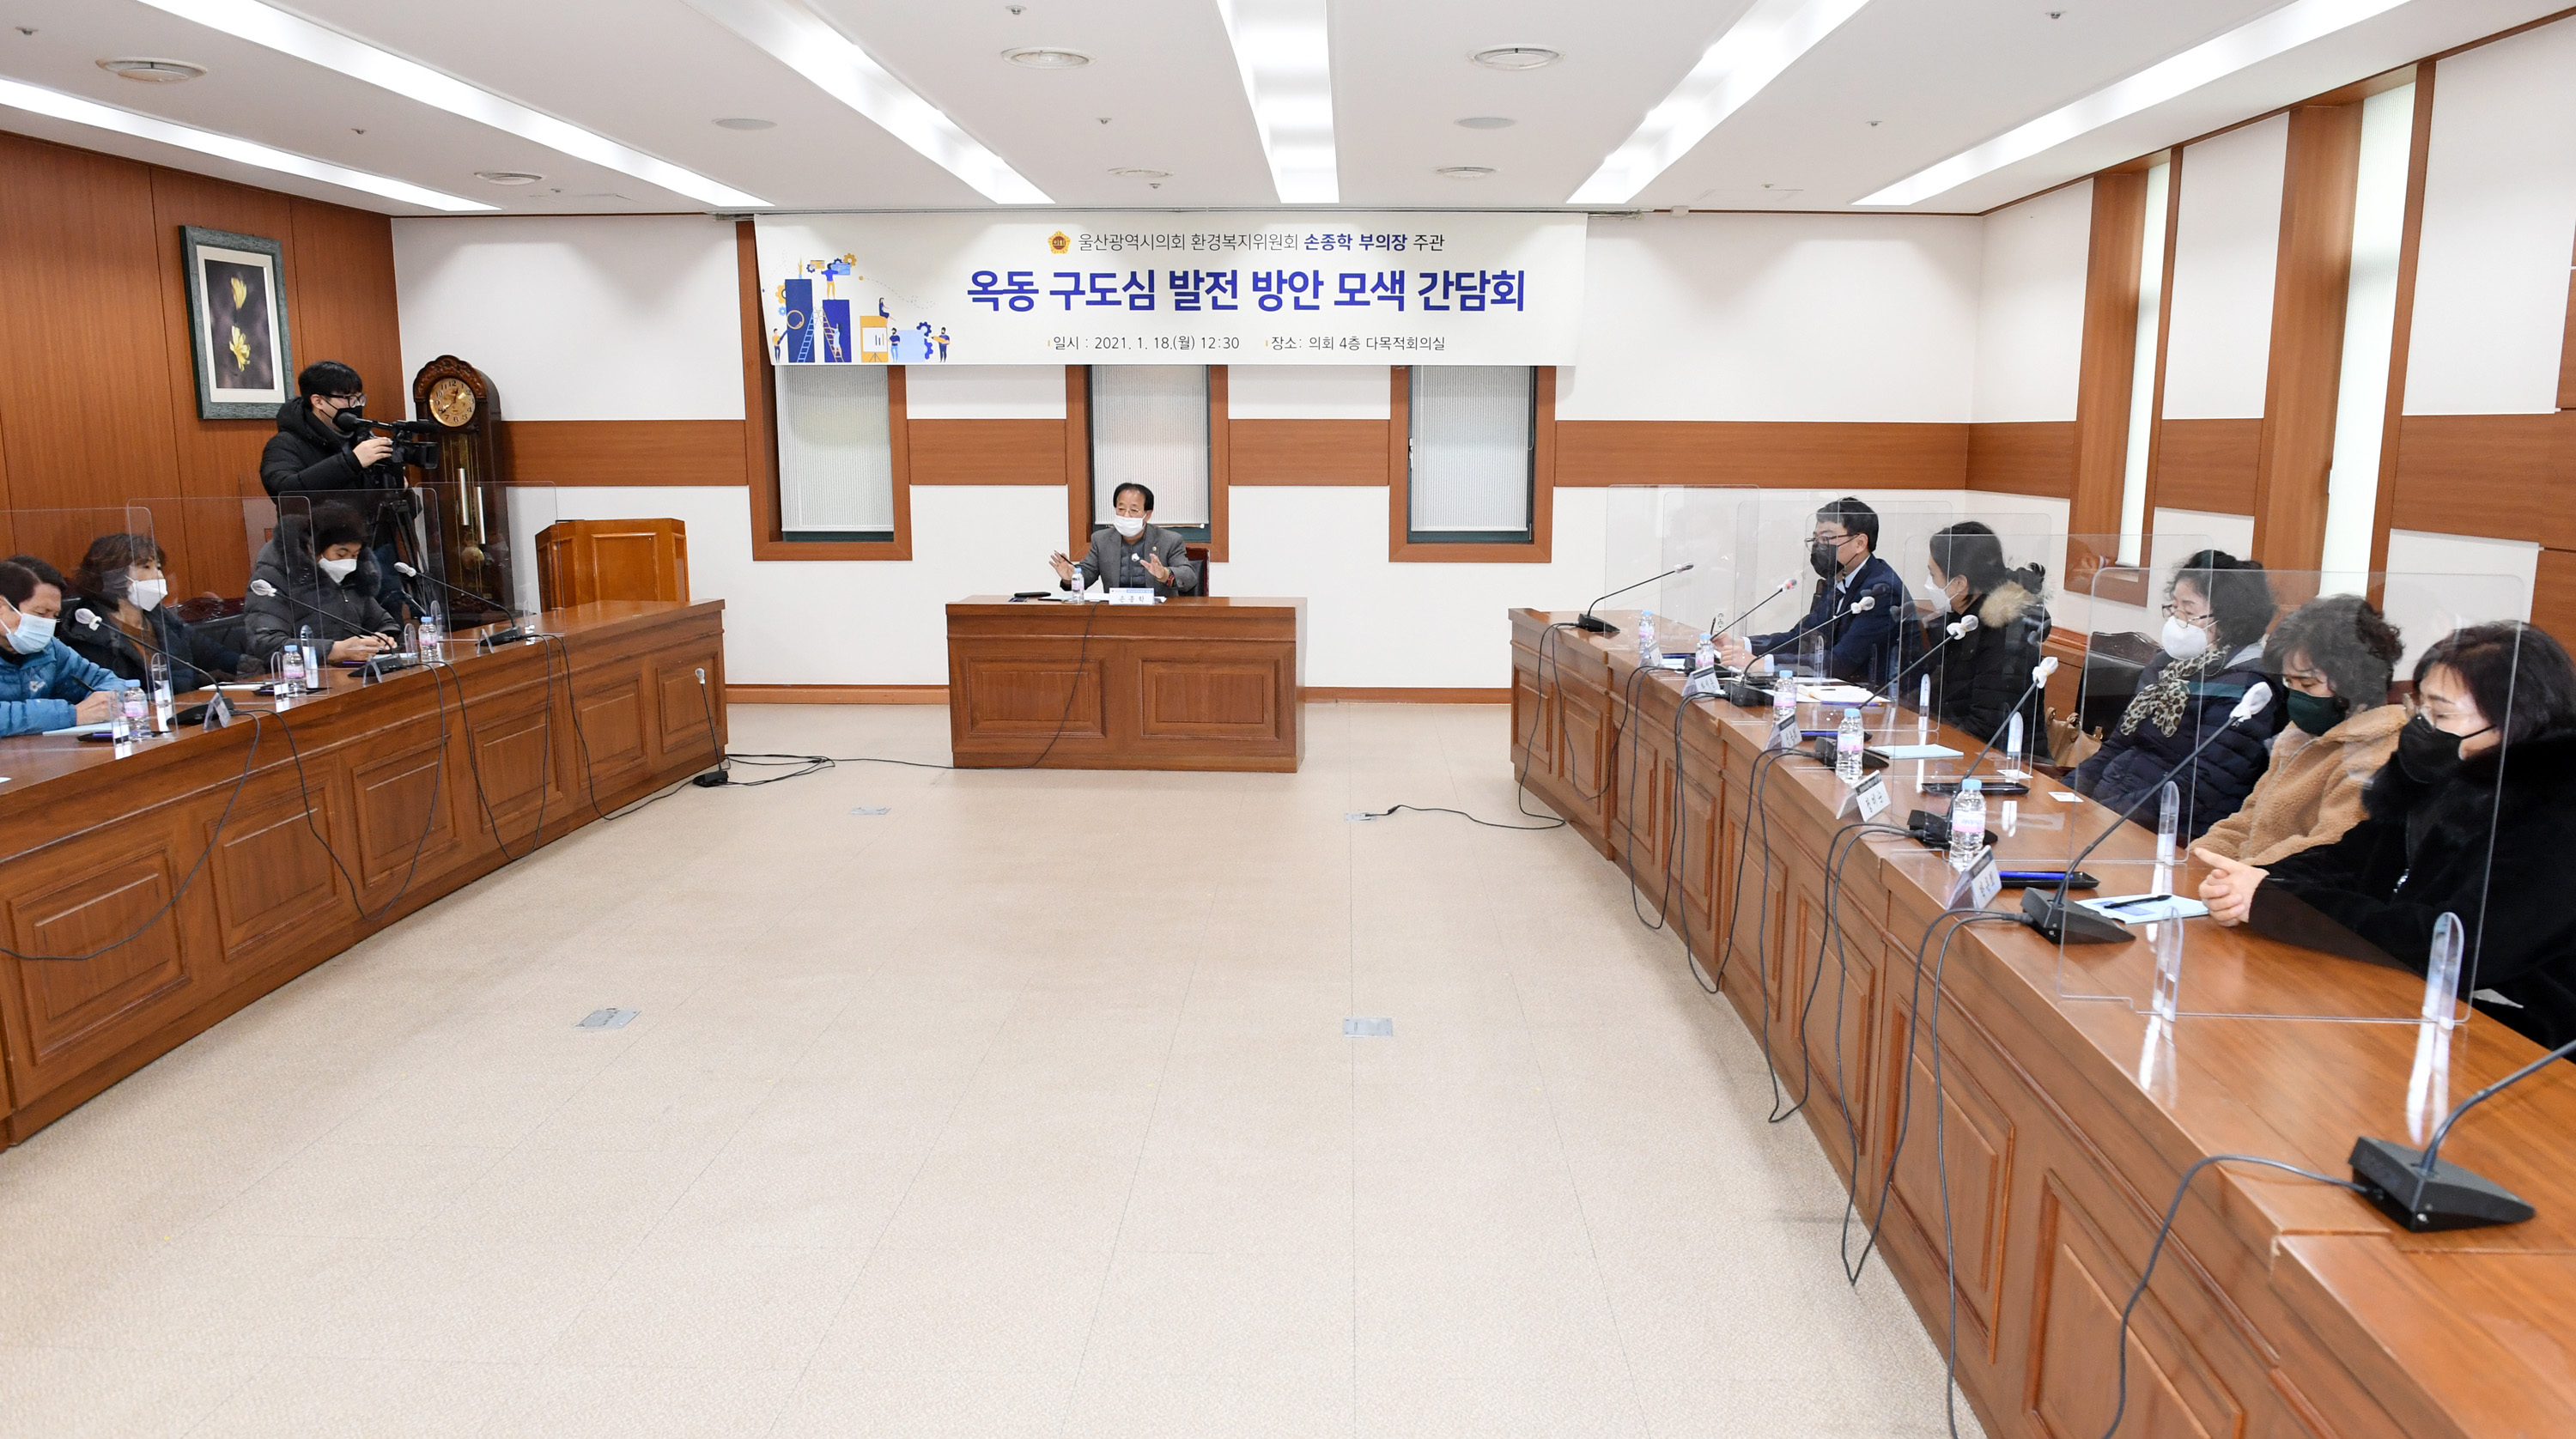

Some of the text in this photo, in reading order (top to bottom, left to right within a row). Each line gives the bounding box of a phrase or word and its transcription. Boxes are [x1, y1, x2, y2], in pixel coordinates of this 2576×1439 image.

[1078, 233, 1445, 252] 울산광역시의회 환경복지위원회 손종학 부의장 주관
[967, 269, 1525, 313] 옥동 구도심 발전 방안 모색 간담회
[1053, 336, 1079, 350] 일시
[1094, 337, 1132, 350] 2021.
[1137, 337, 1148, 350] 1.
[1154, 335, 1195, 351] 18.(월)
[1201, 337, 1240, 350] 12:30
[1309, 336, 1334, 351] 의회
[1339, 336, 1361, 351] 4층
[1366, 336, 1445, 351] 다목적회의실
